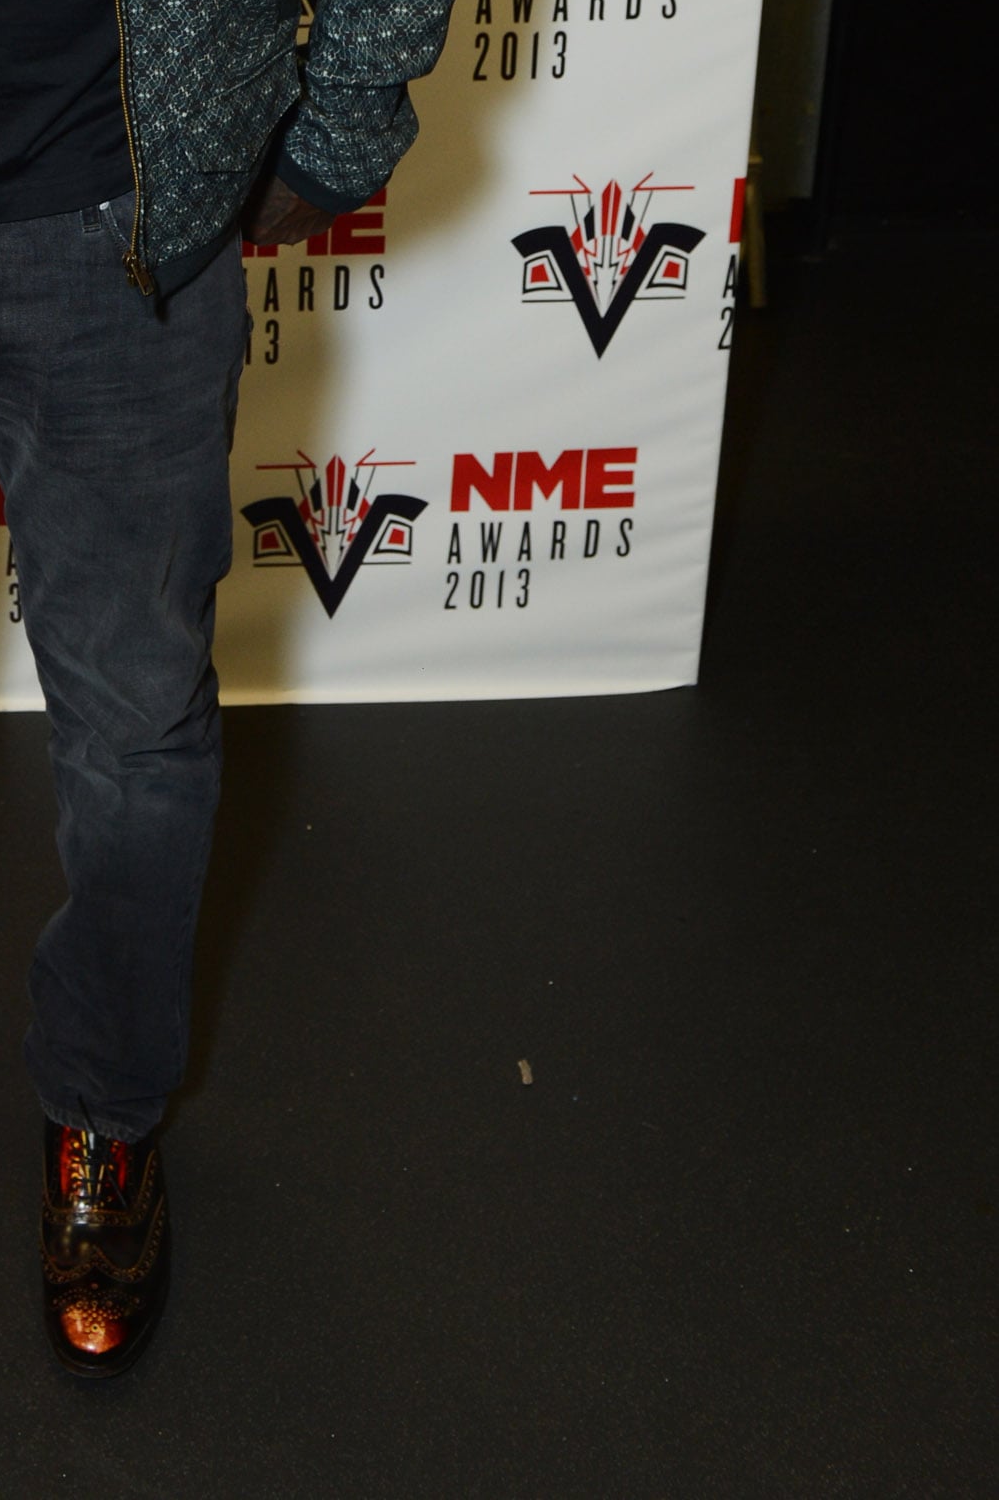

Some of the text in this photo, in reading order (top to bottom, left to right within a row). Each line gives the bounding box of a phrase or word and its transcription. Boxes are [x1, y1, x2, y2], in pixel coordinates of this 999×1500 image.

[473, 31, 566, 82] 2013
[243, 264, 385, 312] ARDS
[450, 447, 638, 512] NME
[448, 517, 634, 565] AWARDS
[444, 568, 530, 610] 2013
